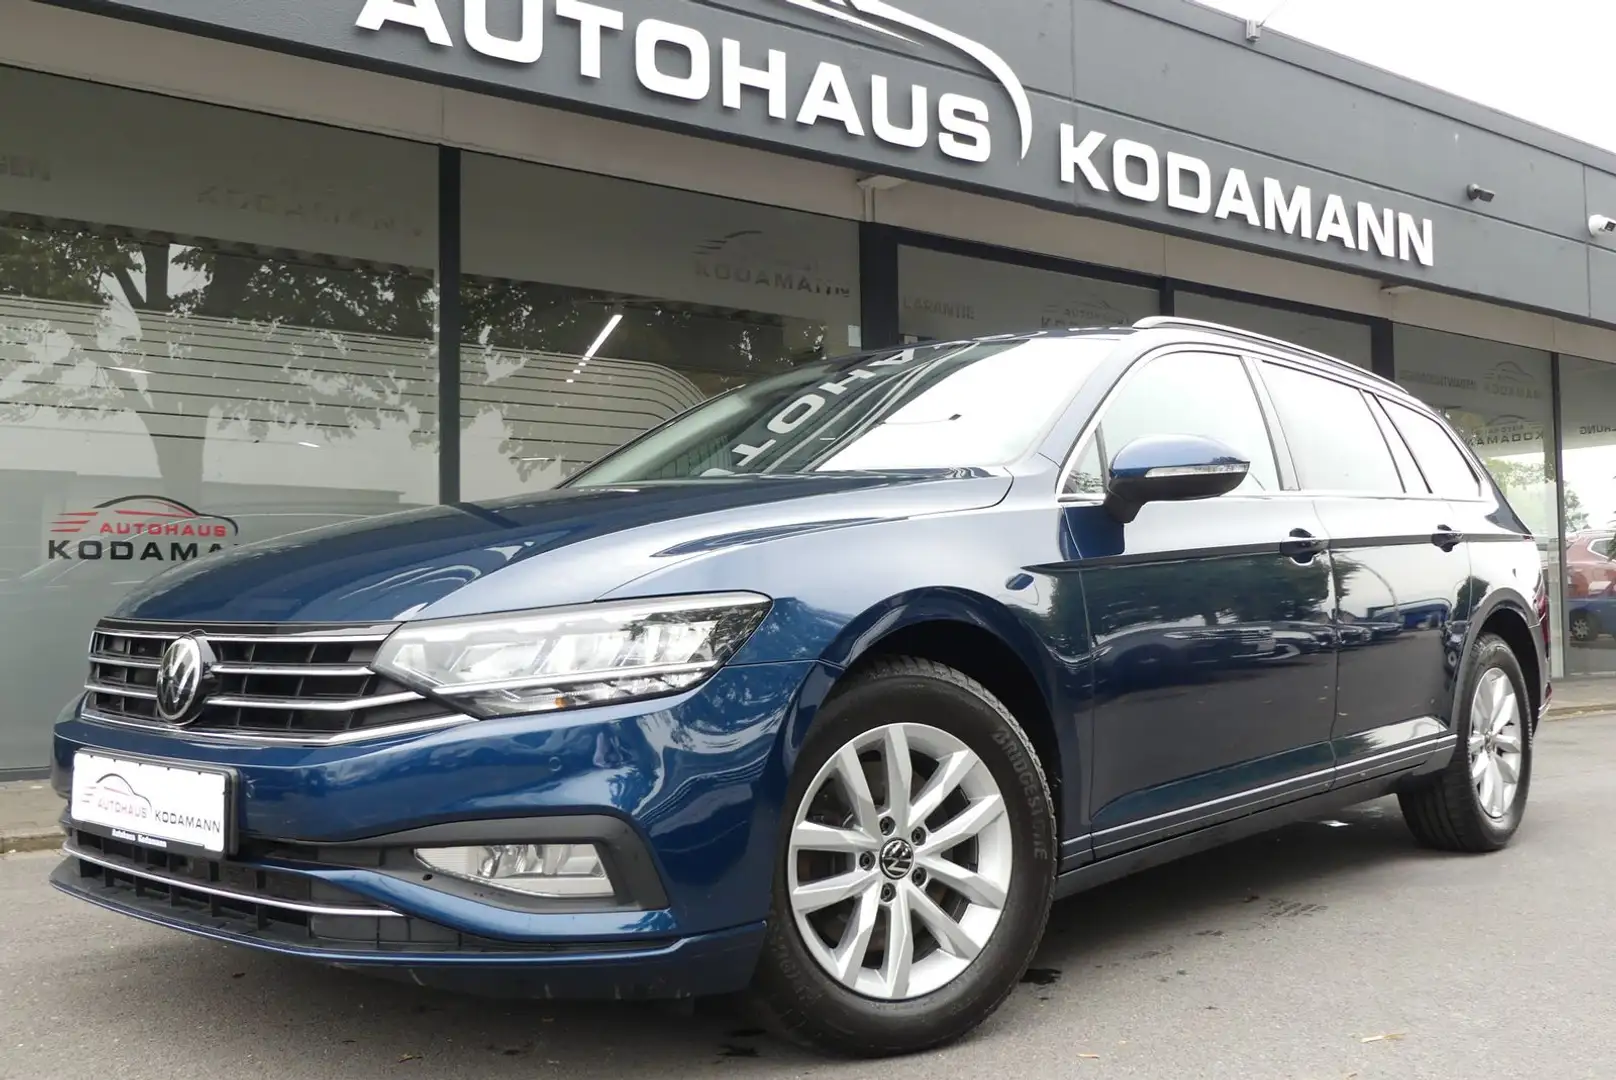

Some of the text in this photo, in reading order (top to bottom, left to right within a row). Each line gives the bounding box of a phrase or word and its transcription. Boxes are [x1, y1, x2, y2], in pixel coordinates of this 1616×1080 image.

[355, 0, 1434, 267] AUTOHAUS KODAMANN
[100, 521, 227, 537] AUTOHAUS
[98, 799, 221, 834] AUTOHAUS KODAMANN
